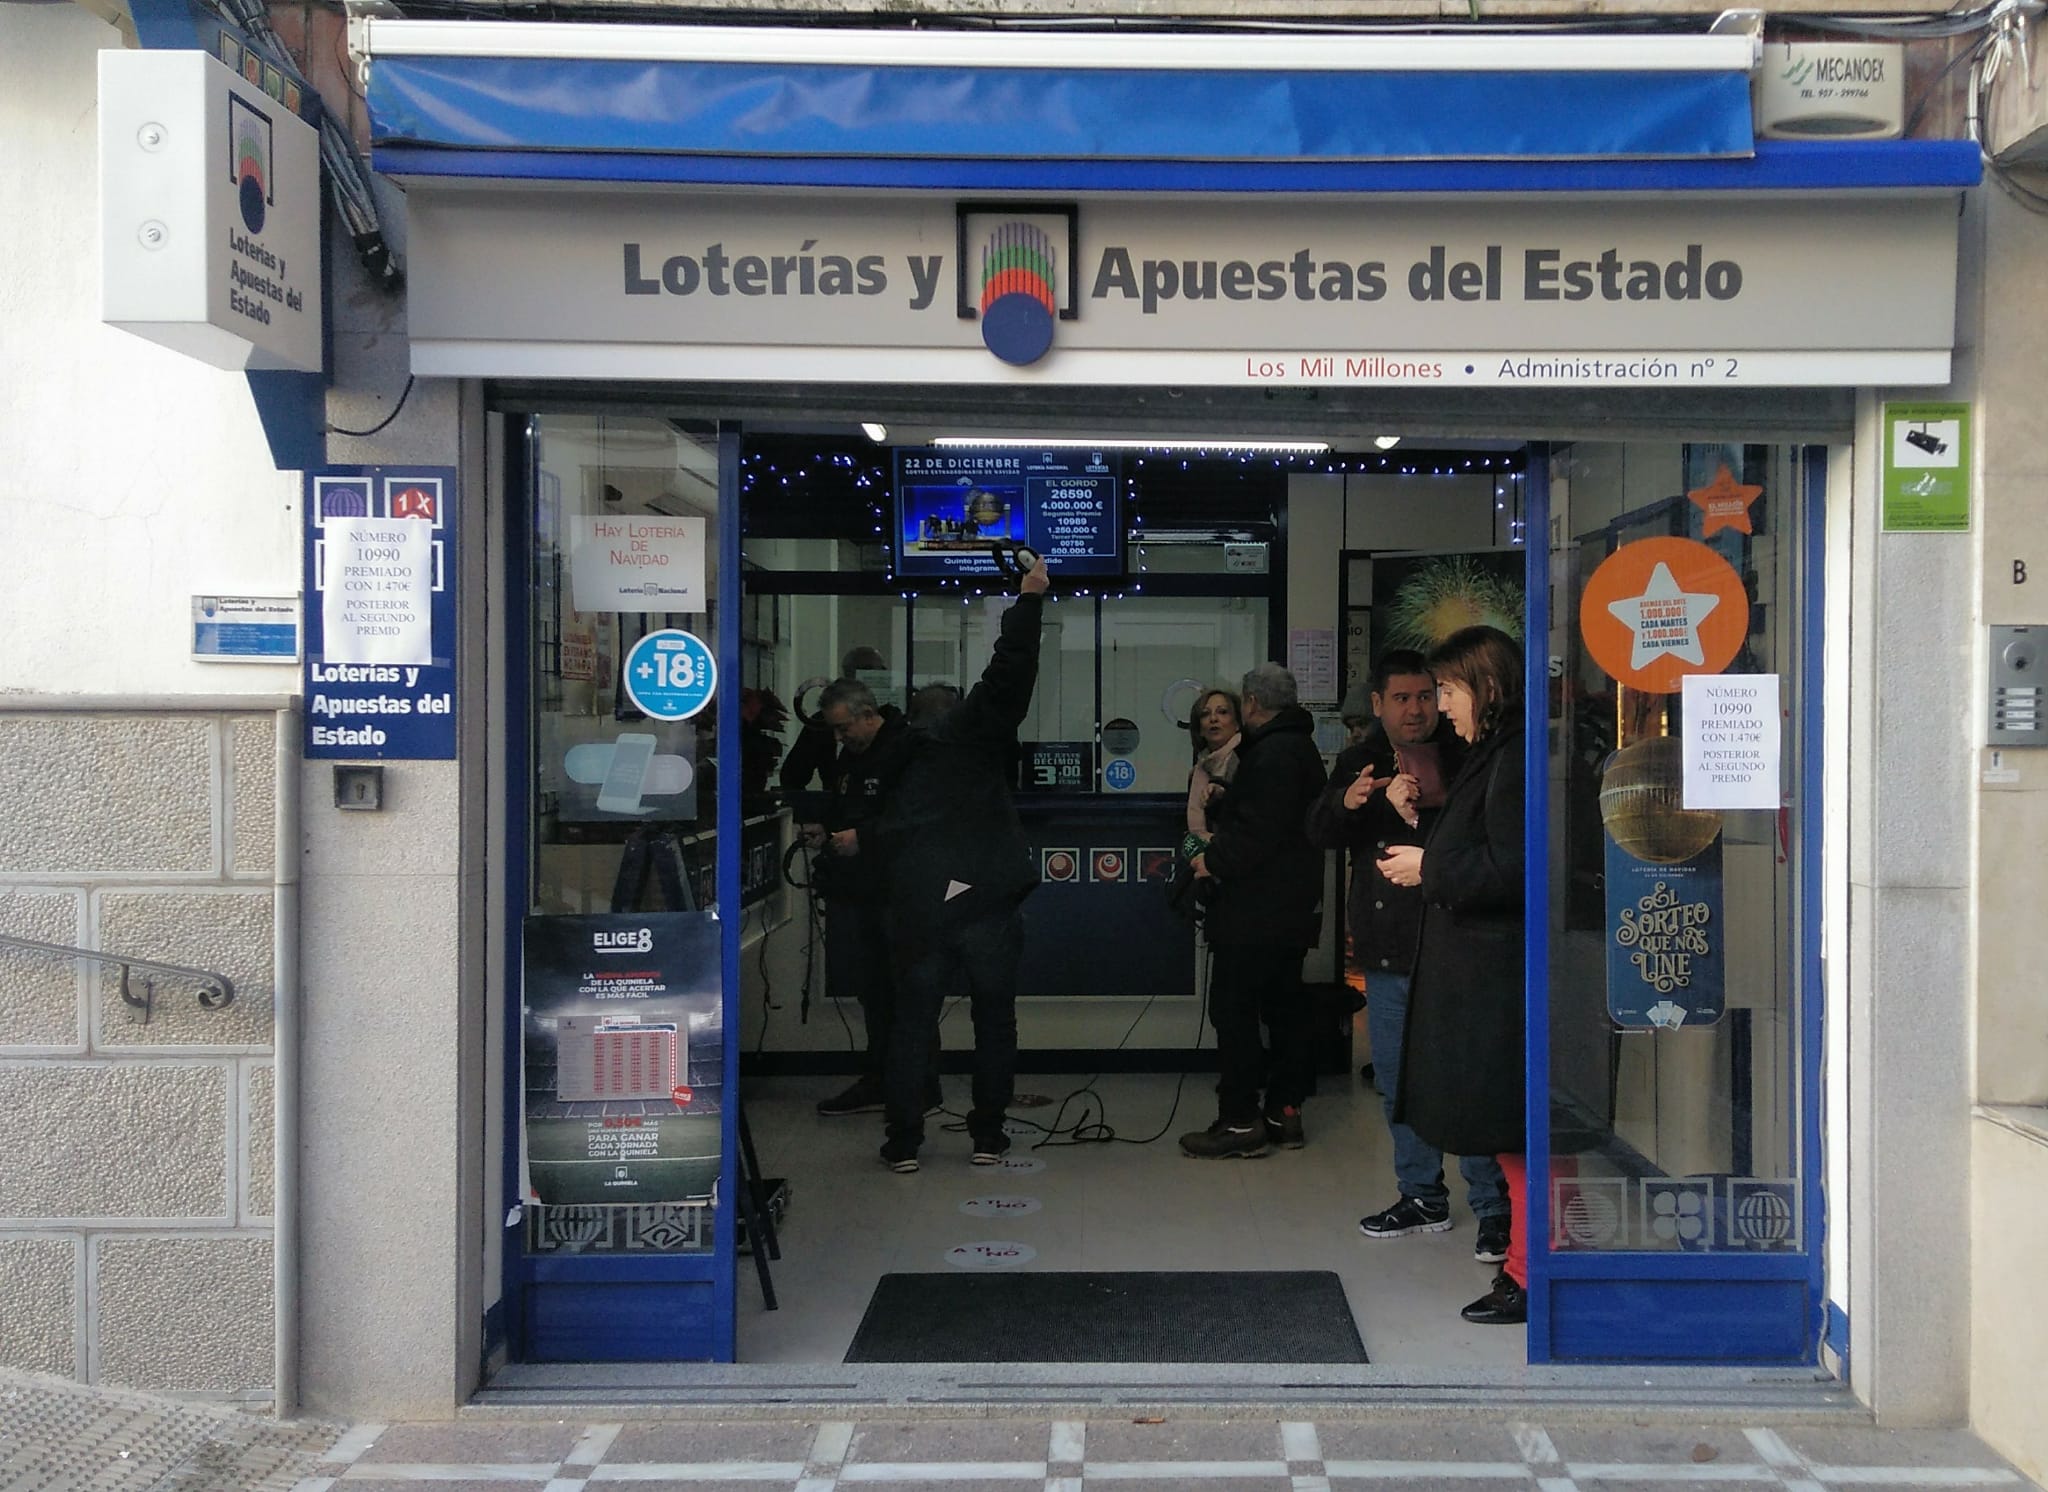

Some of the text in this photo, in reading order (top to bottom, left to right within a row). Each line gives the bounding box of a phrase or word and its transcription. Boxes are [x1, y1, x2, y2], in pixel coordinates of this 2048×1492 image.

[1816, 57, 1885, 82] MECANOEX
[230, 227, 285, 280] Loterías y
[623, 239, 1744, 314] Loterías y Apuestas del Estado
[231, 260, 302, 312] Apuestas del
[231, 288, 270, 325] Estado
[1246, 358, 1285, 379] Los
[1300, 357, 1334, 379] Mil
[1345, 357, 1443, 379] Millones
[1498, 357, 1677, 379] Administración
[1725, 359, 1739, 379] 2
[905, 459, 1020, 468] 22 DE DICIEMBRE
[1051, 489, 1092, 499] 26590
[1041, 501, 1103, 509] 4.000.000 €
[350, 530, 407, 543] NÚMERO
[631, 540, 648, 552] DE
[357, 548, 400, 561] 10990
[610, 550, 669, 566] NAVIDAD
[344, 566, 412, 577] PREMIADO
[2013, 559, 2027, 585] B
[345, 581, 412, 592] CON 1.470€
[346, 599, 410, 610] POSTERIOR
[343, 613, 416, 623] AL SEGUNDO
[1641, 617, 1688, 629] CADA MARTES
[356, 625, 401, 636] PREMIO
[1642, 638, 1689, 648] CADA VIERNES
[311, 663, 419, 688] Loterías y
[636, 653, 695, 688] +18
[697, 656, 705, 687] AÑOS
[1706, 686, 1757, 698] NÚMERO
[311, 693, 450, 719] Apuestas del
[1713, 703, 1752, 715] 10990
[1701, 720, 1763, 729] PREMIADO
[312, 725, 386, 745] Estado
[1701, 733, 1760, 742] CON 1.470€
[1703, 750, 1760, 759] POSTERIOR
[1108, 766, 1129, 779] +18
[1699, 763, 1765, 771] AL SEGUNDO
[1711, 774, 1751, 783] PREMIO
[1638, 881, 1679, 911] EL
[1616, 902, 1710, 946] SORTEO
[1639, 927, 1709, 955] QUE NOS
[1630, 952, 1692, 993] UNE
[588, 1133, 658, 1142] PARA GANAR
